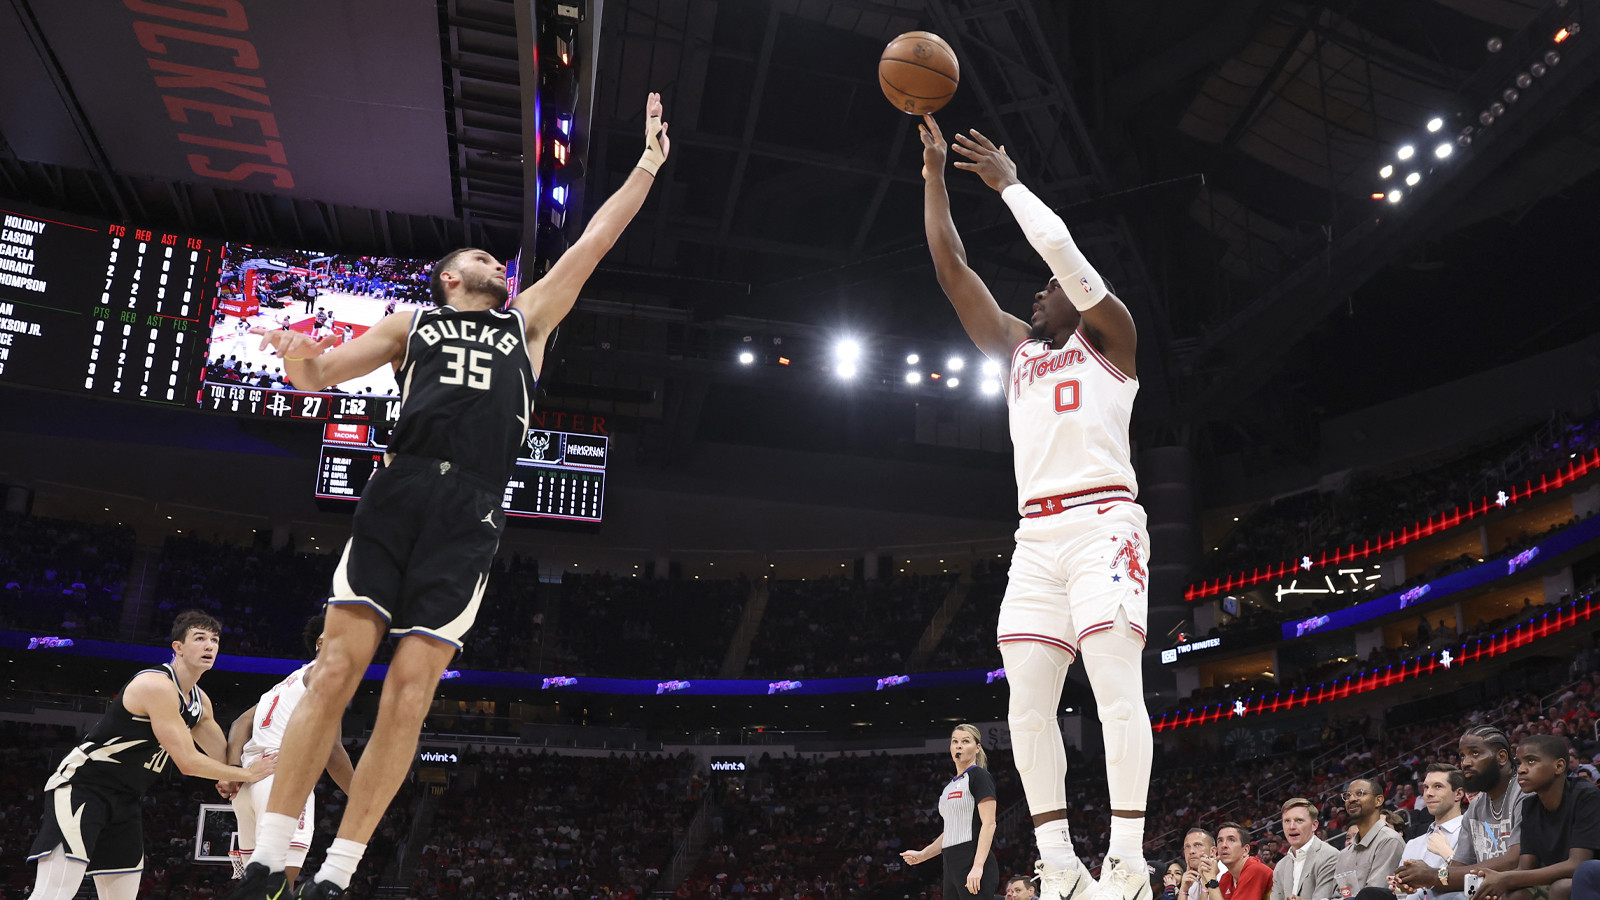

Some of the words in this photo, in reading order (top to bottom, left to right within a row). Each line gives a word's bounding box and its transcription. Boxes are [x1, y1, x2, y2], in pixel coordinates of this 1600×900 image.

[4, 214, 46, 234] HOLIDAY
[112, 238, 120, 249] 3
[138, 242, 146, 254] 0
[165, 247, 172, 258] 0
[190, 251, 198, 262] 0
[108, 224, 126, 237] PTS
[135, 229, 152, 242] REB
[161, 234, 178, 246] AST
[187, 238, 202, 250] FLS
[1, 228, 34, 246] EASON
[110, 251, 118, 263] 3
[138, 256, 143, 267] 1
[162, 260, 170, 272] 0
[190, 264, 195, 276] 1
[0, 243, 34, 261] CAPELA
[106, 265, 115, 276] 2
[134, 270, 141, 281] 4
[160, 274, 168, 285] 0
[187, 278, 192, 289] 1
[105, 278, 112, 290] 7
[131, 283, 138, 294] 2
[158, 287, 165, 299] 3
[183, 291, 191, 302] 0
[101, 292, 110, 304] 0
[128, 297, 136, 308] 2
[156, 301, 162, 312] 1
[181, 305, 188, 316] 0
[93, 306, 110, 319] PTS
[120, 310, 136, 323] REB
[146, 316, 163, 327] AST
[173, 320, 188, 331] FLS
[0, 317, 28, 334] KSON
[28, 323, 42, 336] JR.
[93, 334, 102, 346] 0
[122, 338, 128, 350] 1
[148, 342, 155, 354] 0
[176, 346, 180, 358] 1
[96, 320, 104, 332] 0
[123, 324, 131, 336] 0
[150, 328, 158, 340] 0
[176, 332, 184, 344] 0
[417, 320, 519, 356] BUCKS
[91, 348, 99, 360] 5
[118, 352, 126, 364] 2
[145, 356, 153, 368] 0
[172, 360, 179, 372] 0
[439, 345, 493, 391] 35
[88, 363, 96, 374] 3
[117, 367, 122, 378] 1
[144, 370, 149, 382] 1
[169, 374, 176, 386] 0
[1013, 348, 1087, 402] H-Town
[85, 377, 93, 389] 6
[113, 381, 121, 393] 2
[140, 385, 148, 396] 2
[166, 388, 174, 400] 0
[210, 386, 225, 398] TOL
[229, 388, 244, 400] FLS
[249, 390, 262, 402] CC
[1053, 377, 1082, 415] 0
[214, 398, 220, 409] 7
[252, 402, 256, 413] 1
[302, 396, 322, 417] 27
[340, 398, 366, 415] 1:52
[386, 401, 400, 421] 14
[1177, 643, 1191, 654] TWO
[1192, 638, 1220, 651] MINUTES!
[260, 693, 280, 729] 1
[420, 752, 448, 762] vivint
[711, 761, 737, 770] vivint
